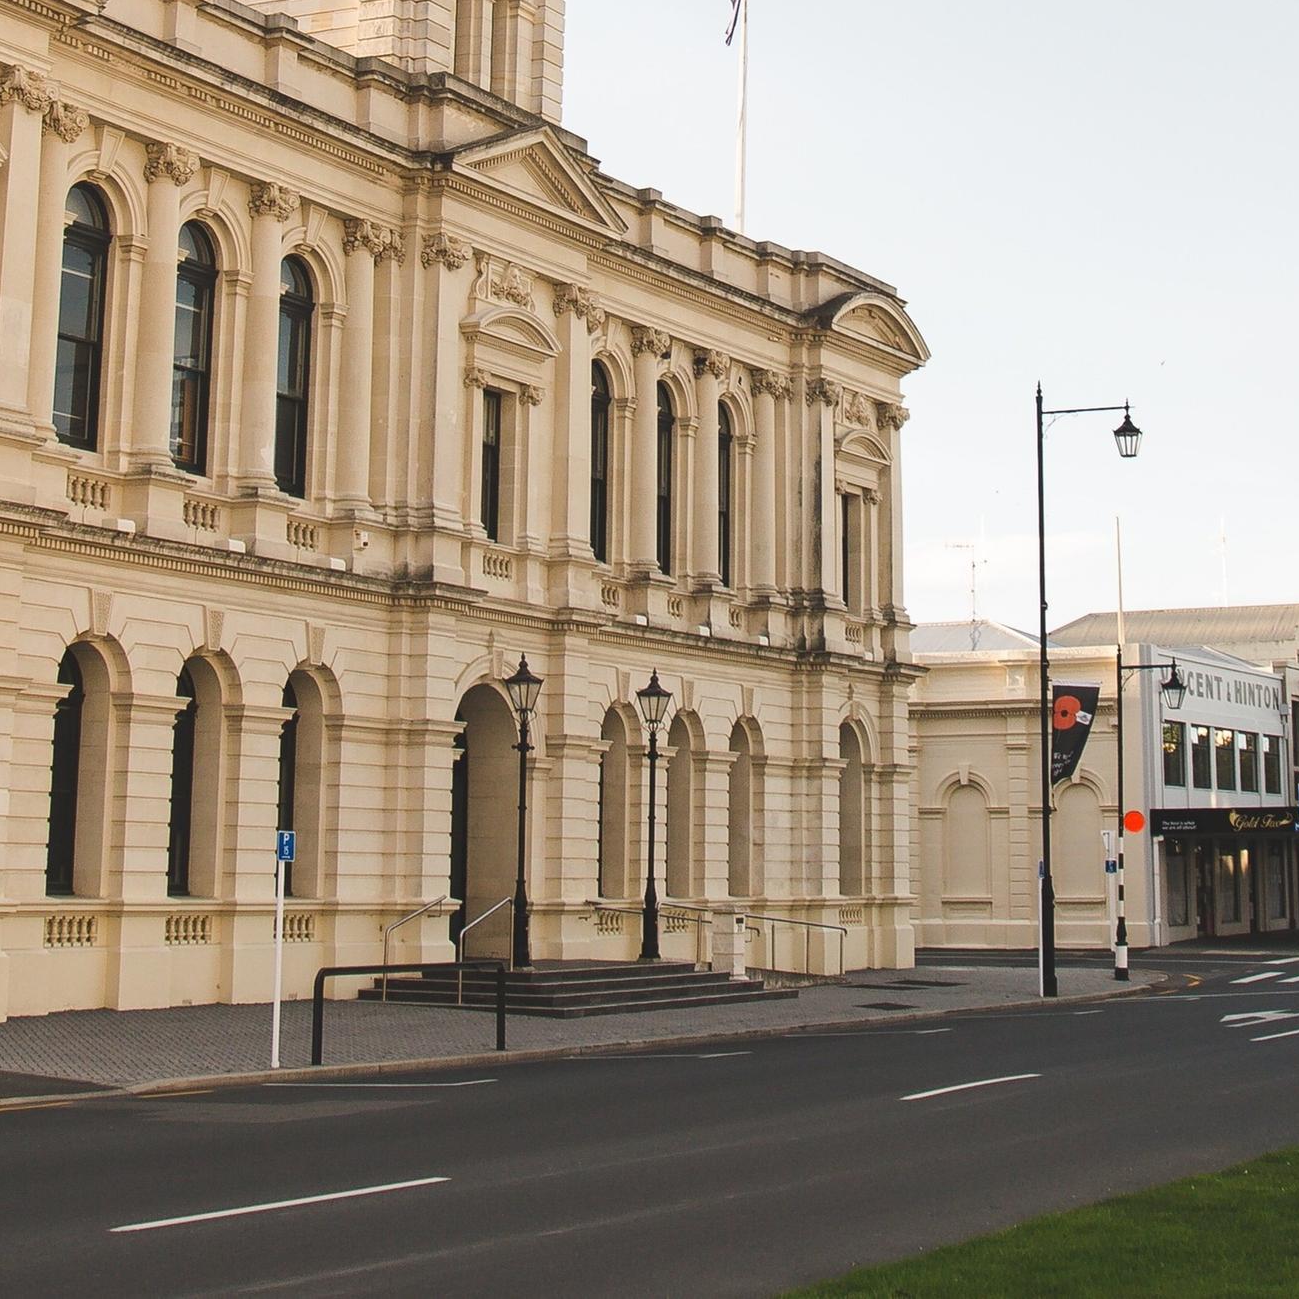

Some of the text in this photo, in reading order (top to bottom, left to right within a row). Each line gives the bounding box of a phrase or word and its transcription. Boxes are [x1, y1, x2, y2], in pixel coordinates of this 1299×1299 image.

[1161, 666, 1223, 701] VNCENT
[1234, 679, 1280, 711] HINTON
[283, 833, 290, 845] P
